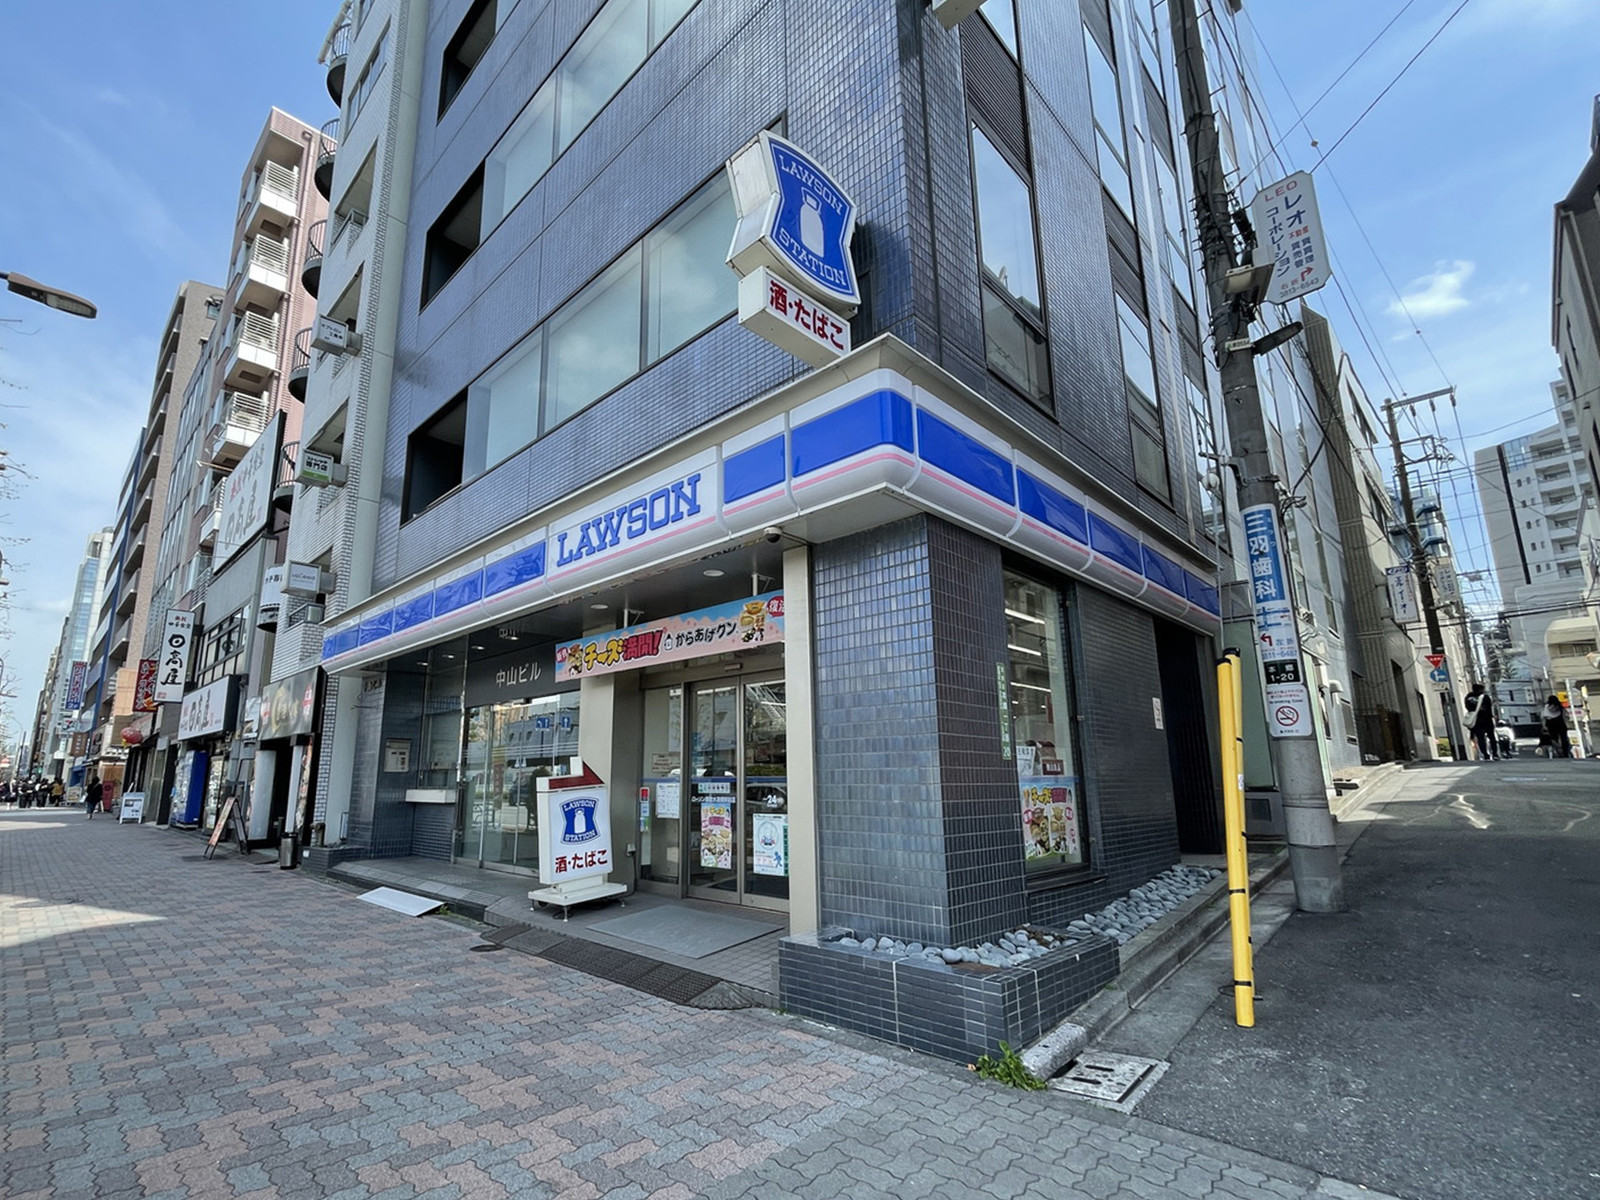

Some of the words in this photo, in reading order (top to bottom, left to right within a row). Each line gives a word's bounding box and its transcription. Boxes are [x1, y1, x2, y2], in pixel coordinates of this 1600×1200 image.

[779, 154, 843, 216] LAWSON
[1265, 180, 1298, 202] LEO
[1285, 194, 1306, 229] レオ
[1265, 206, 1290, 278] コーポレーション
[1288, 225, 1309, 239] 不動産
[779, 227, 846, 286] STATION
[556, 473, 701, 567] LAWSON
[1246, 513, 1278, 600] 三羽歯科
[676, 622, 737, 648] からあげクン
[160, 633, 186, 686] 日高屋
[495, 661, 541, 688] 中山ビル
[1270, 673, 1295, 682] 1-20
[563, 800, 596, 812] LAWSON
[564, 829, 596, 842] STATION
[555, 849, 608, 874] 酒・たばこ
